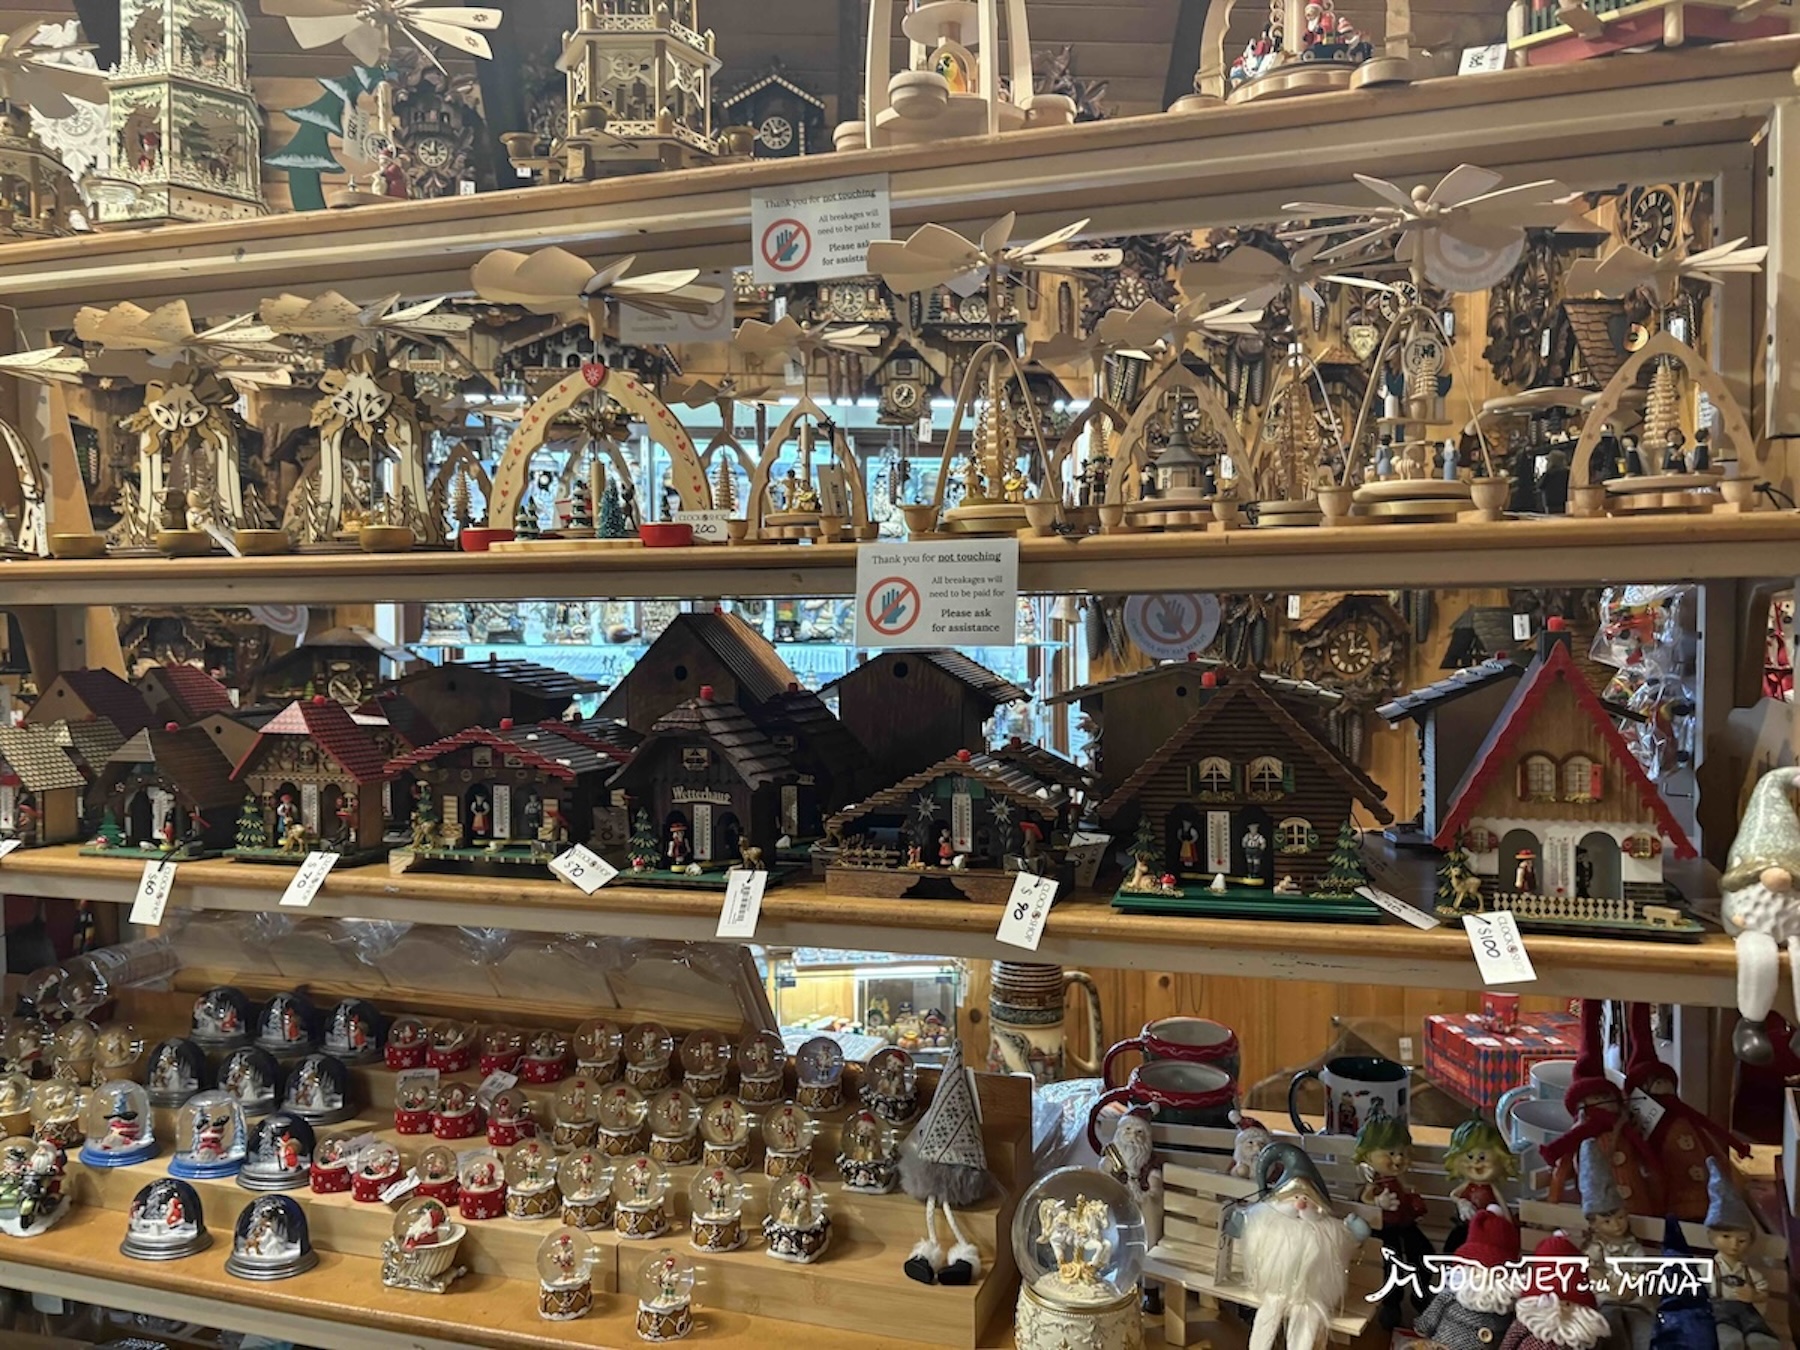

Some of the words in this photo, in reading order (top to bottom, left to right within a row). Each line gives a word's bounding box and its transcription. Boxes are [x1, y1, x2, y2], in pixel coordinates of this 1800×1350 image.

[764, 200, 791, 209] Thank
[792, 198, 808, 208] you
[809, 195, 821, 204] for
[823, 193, 837, 203] not
[838, 189, 876, 200] touching
[819, 215, 829, 223] All
[829, 211, 865, 222] breakages
[865, 208, 879, 217] will
[817, 227, 834, 236] need
[835, 225, 843, 233] to
[844, 224, 853, 232] be
[854, 222, 869, 233] paid
[871, 221, 881, 230] for
[829, 243, 855, 252] Please
[822, 257, 833, 266] for
[872, 555, 901, 565] Thank
[903, 556, 920, 566] you
[922, 553, 936, 562] for
[938, 553, 955, 563] not
[957, 552, 1002, 563] touching
[944, 576, 986, 586] breakages
[987, 575, 1003, 583] will
[929, 590, 949, 598] need
[950, 590, 960, 598] to
[961, 589, 971, 597] be
[972, 588, 991, 599] paid
[993, 588, 1006, 597] for
[941, 608, 971, 618] Please
[974, 608, 991, 618] ask
[932, 623, 946, 633] for
[948, 623, 1000, 632] assistance
[1034, 882, 1051, 911] CLOCK
[1496, 916, 1514, 946] CLOCK
[1477, 927, 1501, 959] $100
